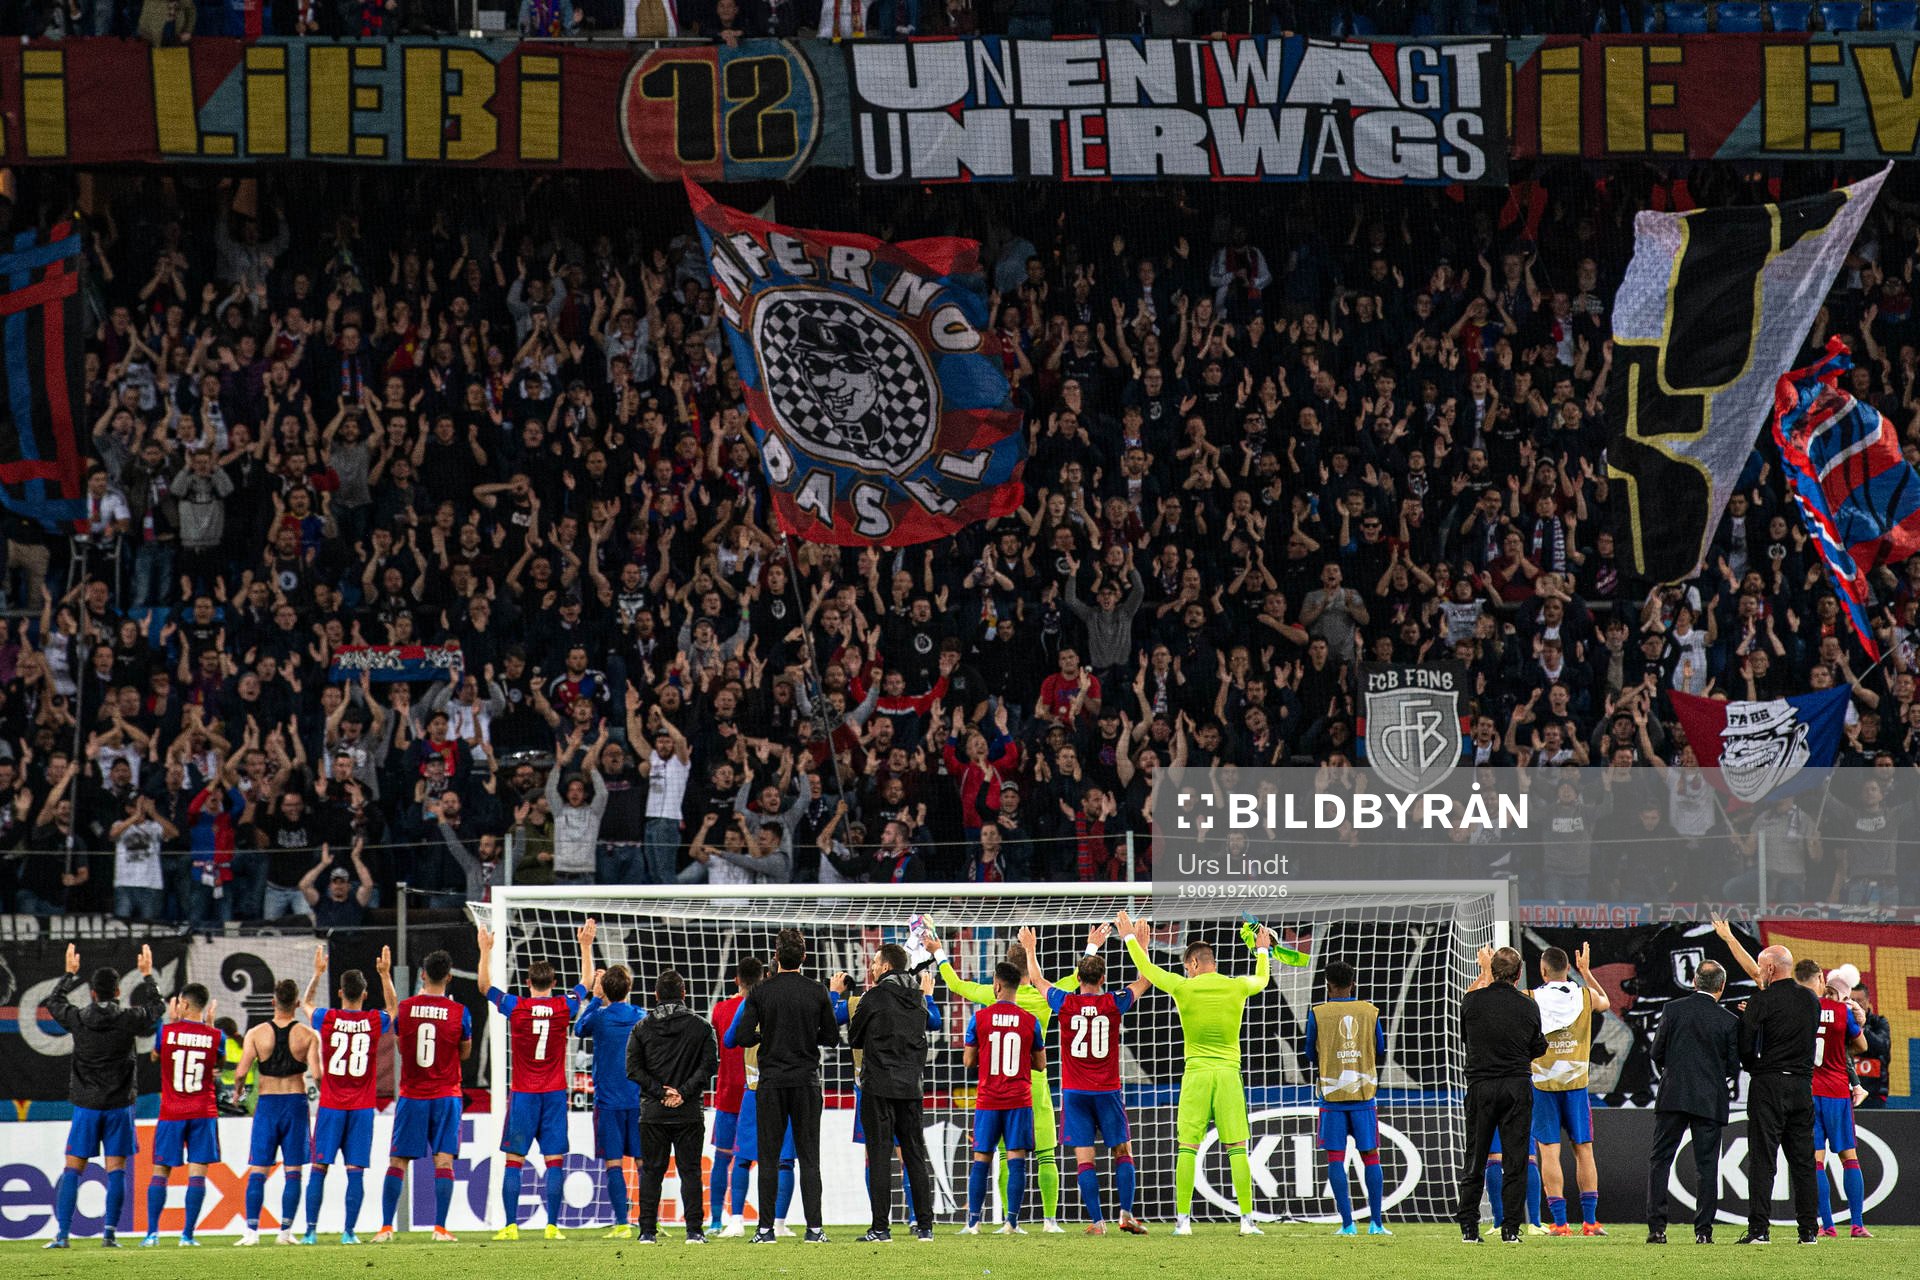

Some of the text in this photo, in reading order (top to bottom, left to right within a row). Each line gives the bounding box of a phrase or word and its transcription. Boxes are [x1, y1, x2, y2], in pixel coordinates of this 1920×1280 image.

[852, 39, 1491, 109] UNENTWÄGT
[639, 58, 799, 164] 12
[860, 107, 1488, 181] UNTERWÄGS
[711, 231, 982, 352] INFERNO
[761, 431, 993, 539] BASEL
[1368, 668, 1454, 691] FCB FANS
[532, 1019, 550, 1060] 7
[992, 1013, 1019, 1027] CAMPO
[1070, 1015, 1110, 1059] 20
[328, 1031, 371, 1077] 28
[416, 1022, 436, 1068] 6
[988, 1031, 1021, 1077] 10
[171, 1049, 206, 1093] 15
[1232, 1135, 1370, 1198] KIA
